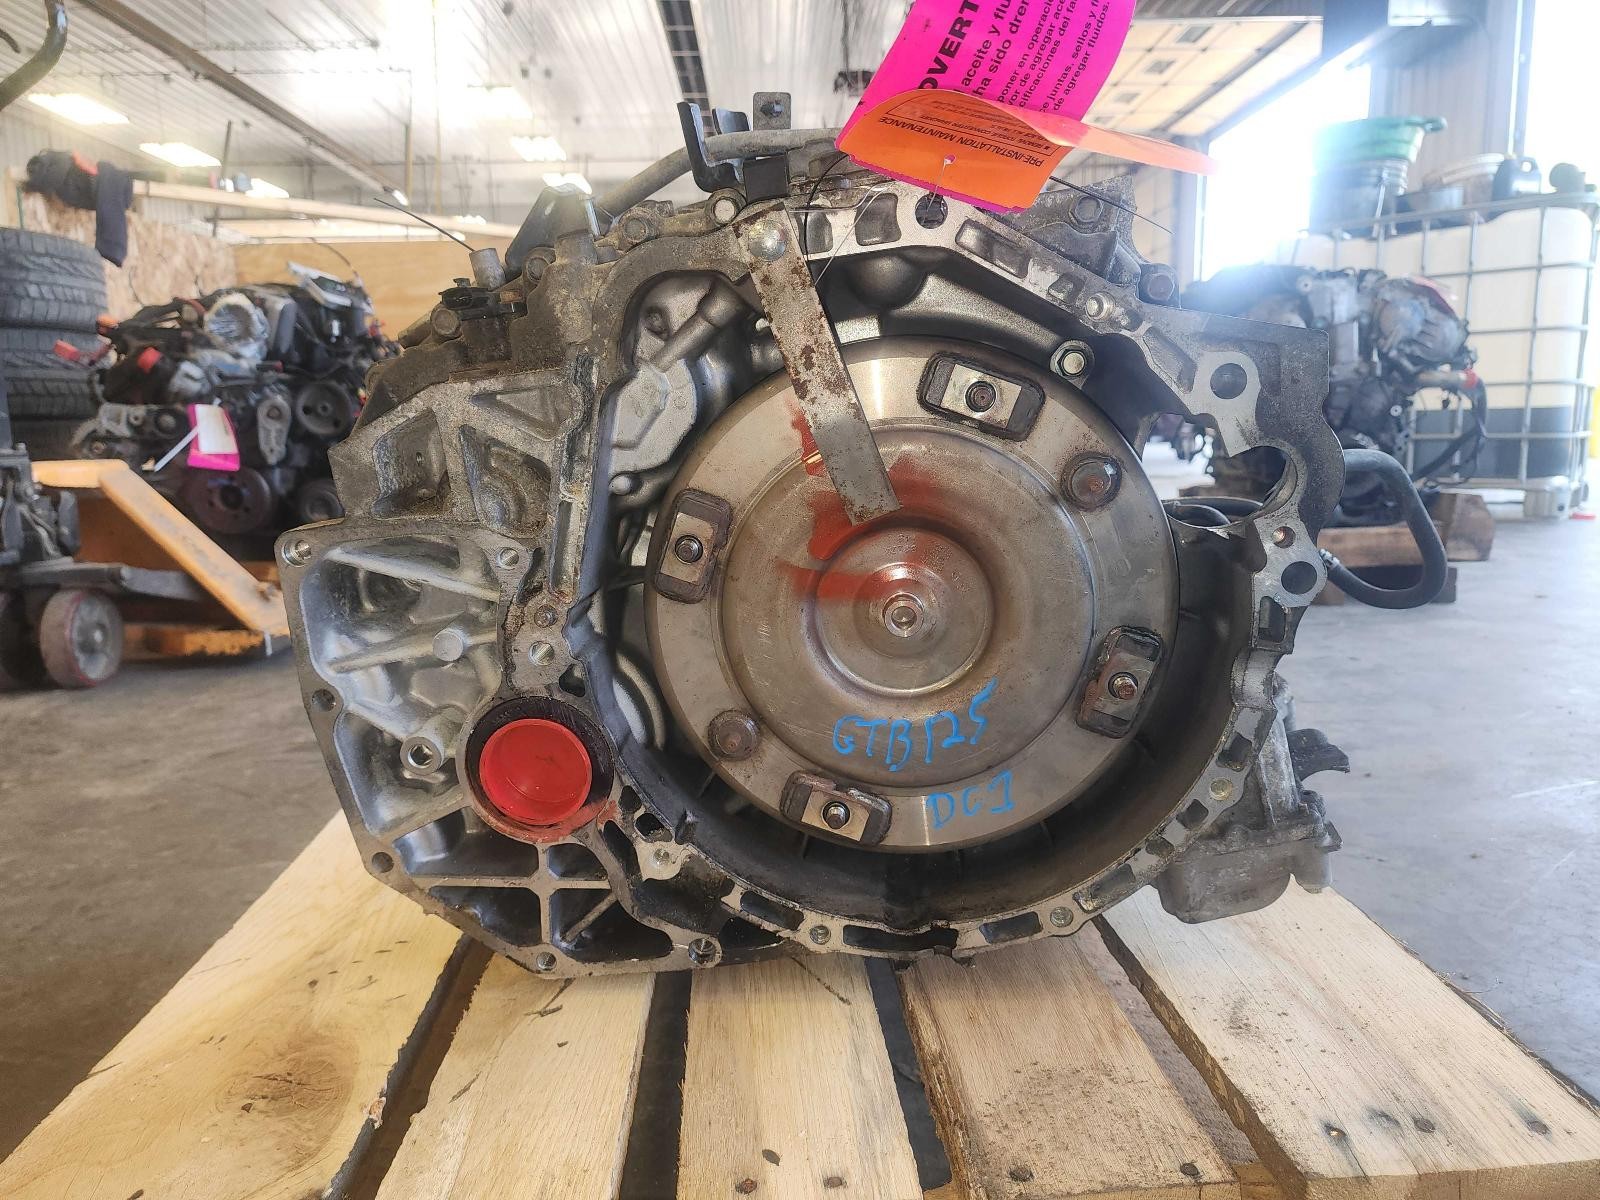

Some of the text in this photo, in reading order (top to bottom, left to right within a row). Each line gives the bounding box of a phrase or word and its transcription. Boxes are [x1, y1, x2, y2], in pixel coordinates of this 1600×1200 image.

[961, 40, 992, 86] aceite
[988, 24, 1001, 36] y
[972, 77, 992, 95] ha
[988, 39, 1012, 73] sido
[997, 70, 1020, 103] poner
[1018, 53, 1029, 68] en
[1019, 39, 1060, 107] cificaciones
[1058, 16, 1070, 36] del
[1020, 73, 1030, 87] de
[1029, 22, 1056, 70] agregar
[1046, 63, 1075, 101] juntas,
[1072, 22, 1091, 59] sellos
[1089, 10, 1097, 19] y
[1053, 2, 1110, 111] de agregar fluidos.
[879, 116, 957, 141] MAINTENANCE
[956, 136, 1044, 167] PRE-INSTALLATION
